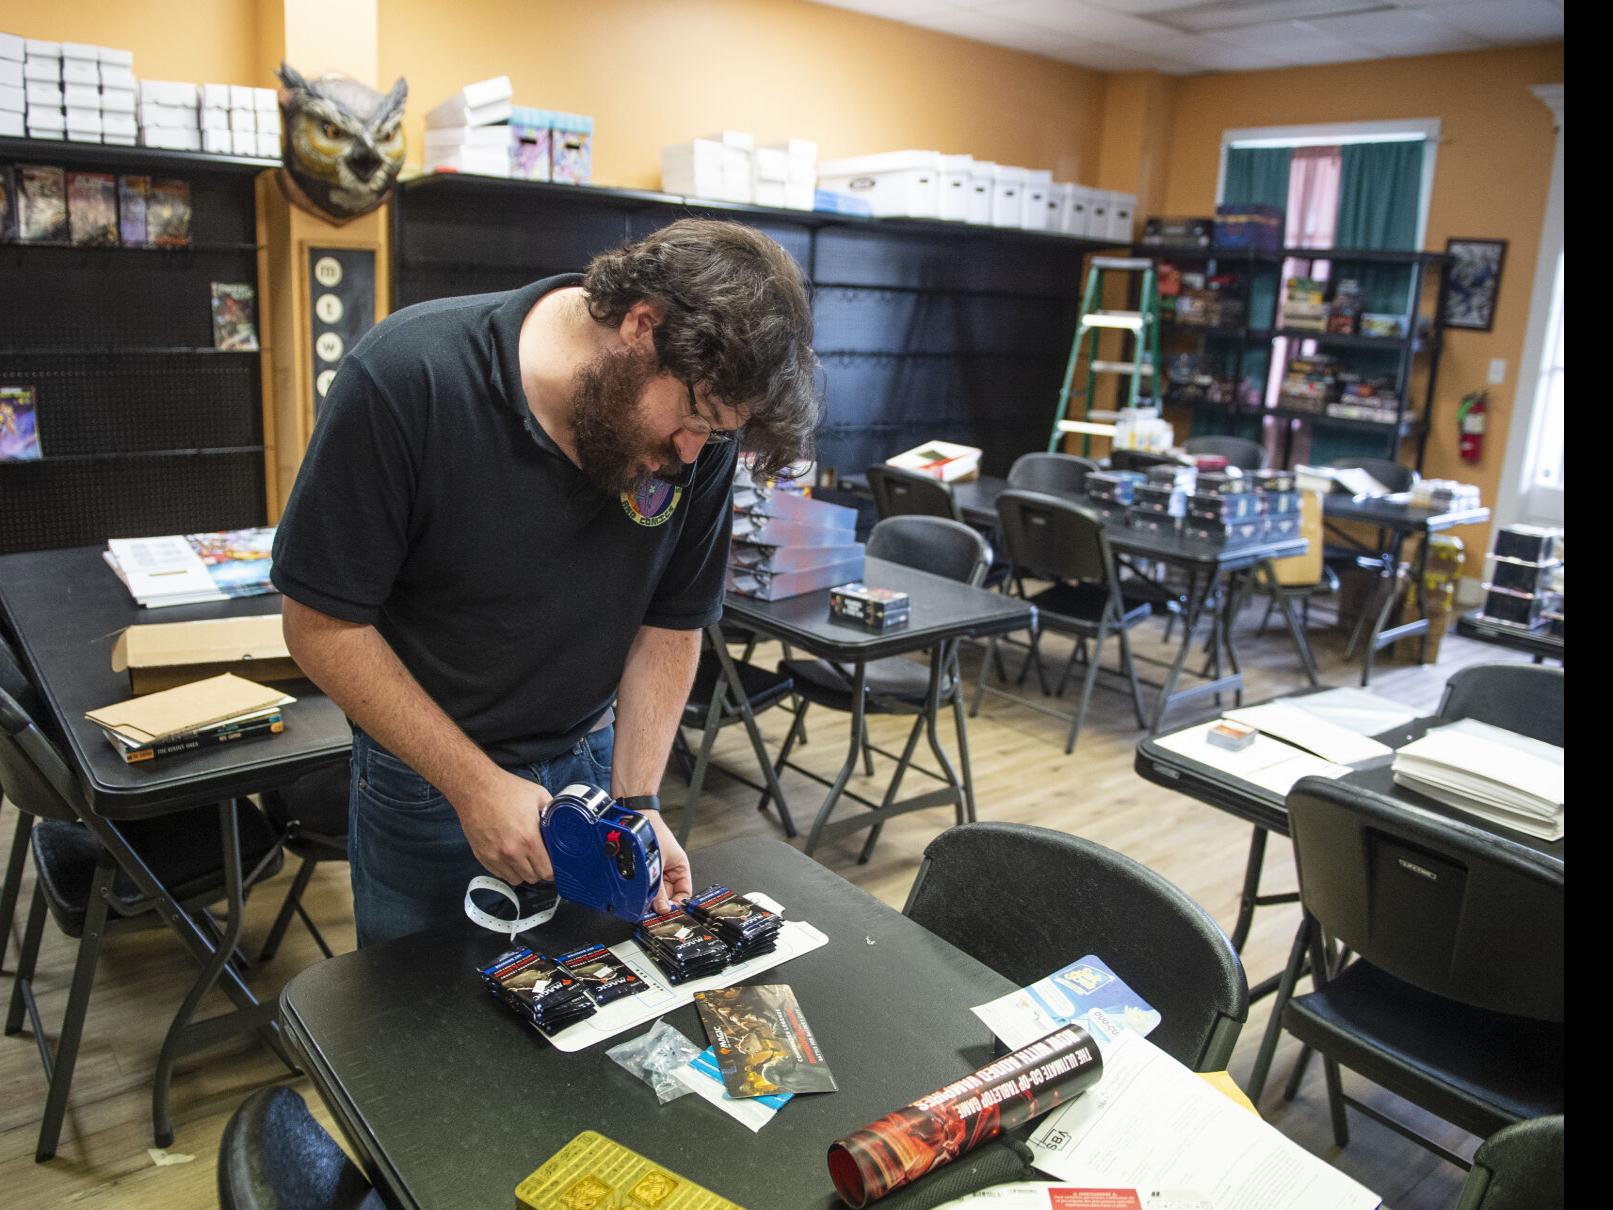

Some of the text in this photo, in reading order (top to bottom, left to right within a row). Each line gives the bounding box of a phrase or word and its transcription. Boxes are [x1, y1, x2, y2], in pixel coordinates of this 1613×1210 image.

[320, 266, 338, 278] m
[323, 343, 336, 353] w
[596, 977, 626, 992] MAGIC
[1014, 1041, 1054, 1064] WITH
[1044, 1029, 1081, 1053] NOW
[1040, 1053, 1079, 1081] ULTIMATE
[1075, 1047, 1093, 1065] THE
[975, 1056, 1022, 1082] ADDED
[1018, 1068, 1044, 1092] CO-OP
[981, 1079, 1020, 1109] TABLETOP
[1046, 1129, 1068, 1151] SBA
